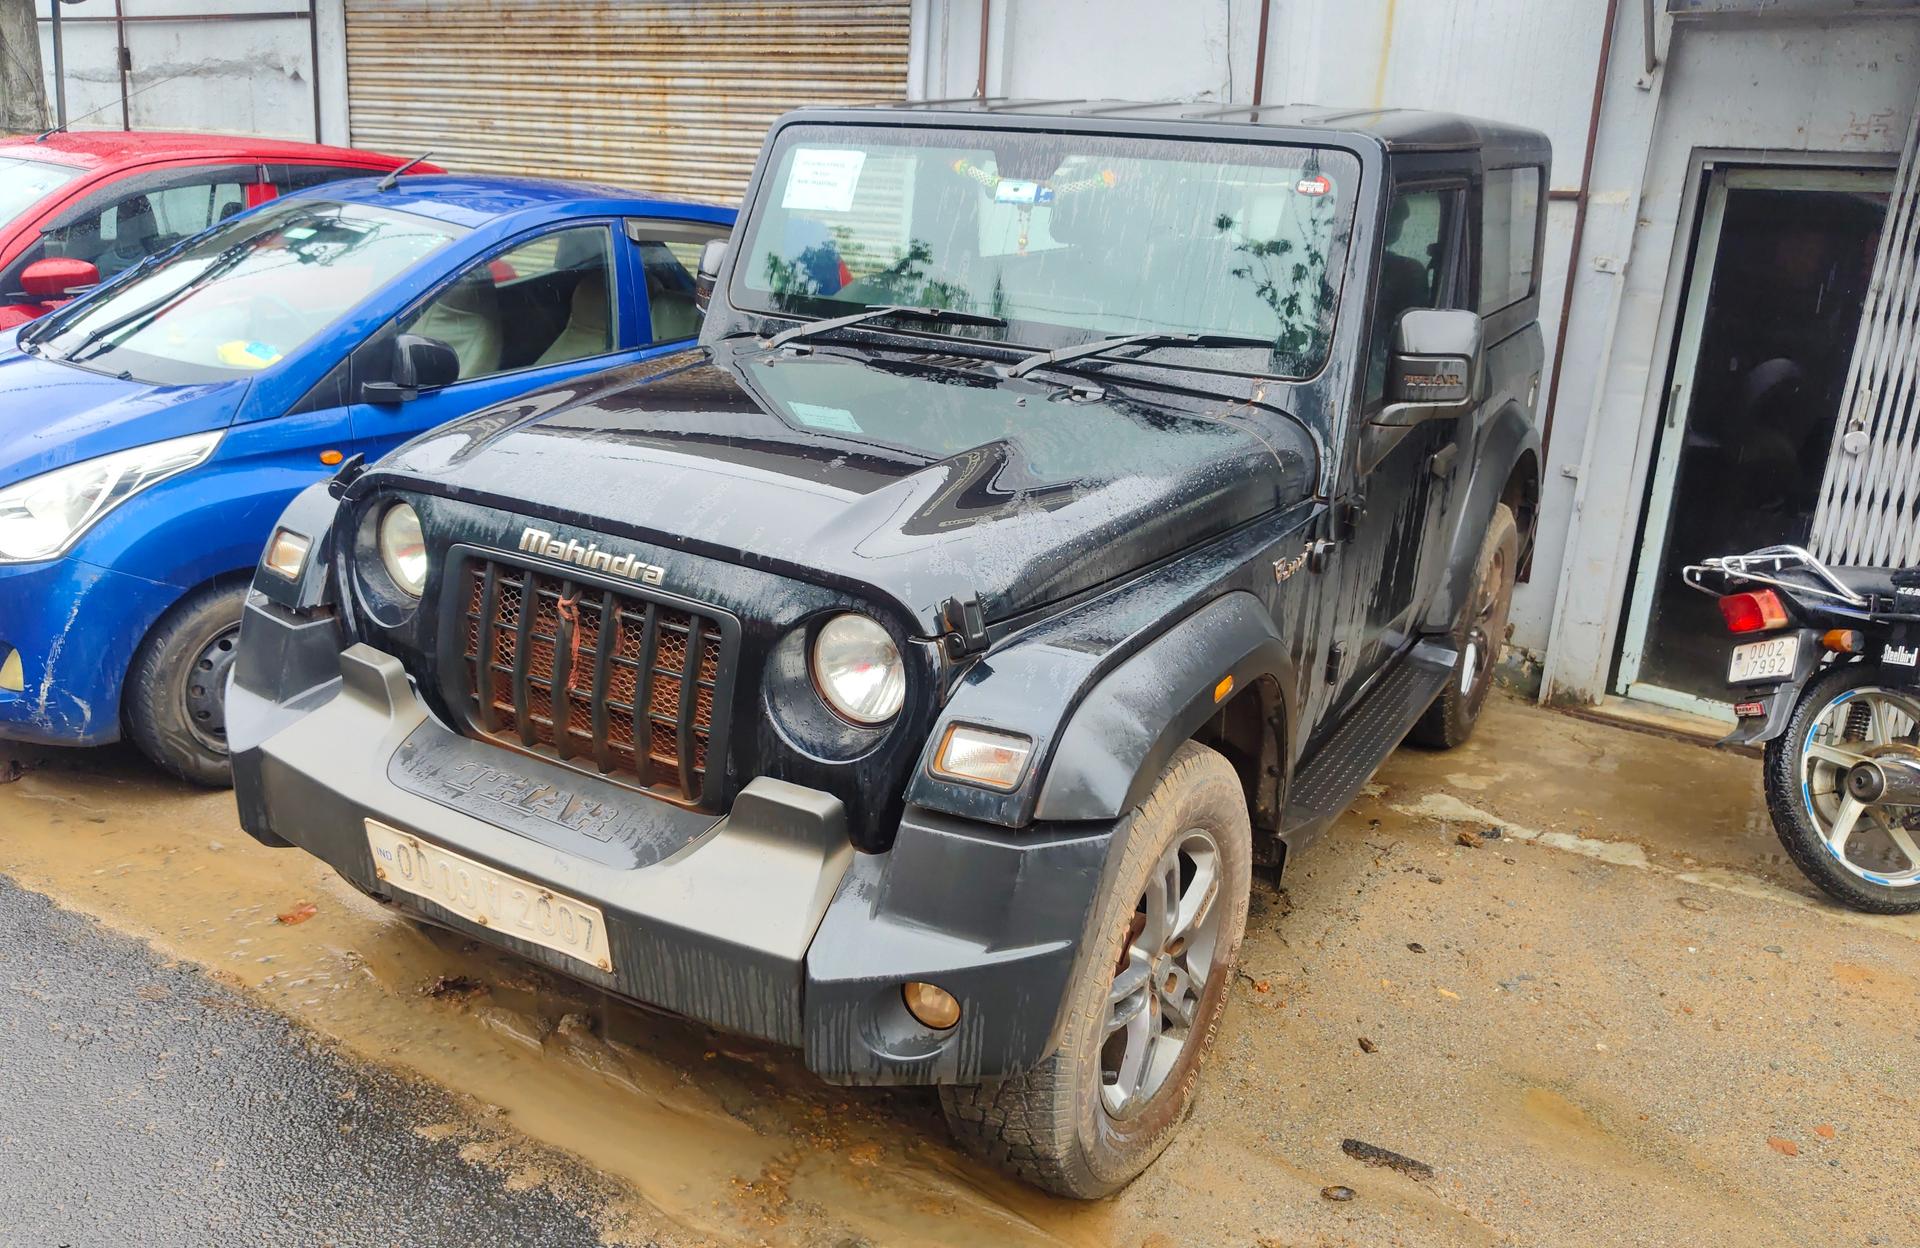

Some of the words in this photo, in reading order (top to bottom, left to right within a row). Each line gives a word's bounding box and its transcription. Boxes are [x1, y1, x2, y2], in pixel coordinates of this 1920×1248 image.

[518, 527, 665, 586] Mahindra
[1881, 644, 1918, 666] Steelbird
[1742, 657, 1786, 677] J7992
[444, 761, 620, 844] THAR
[376, 847, 392, 861] IND
